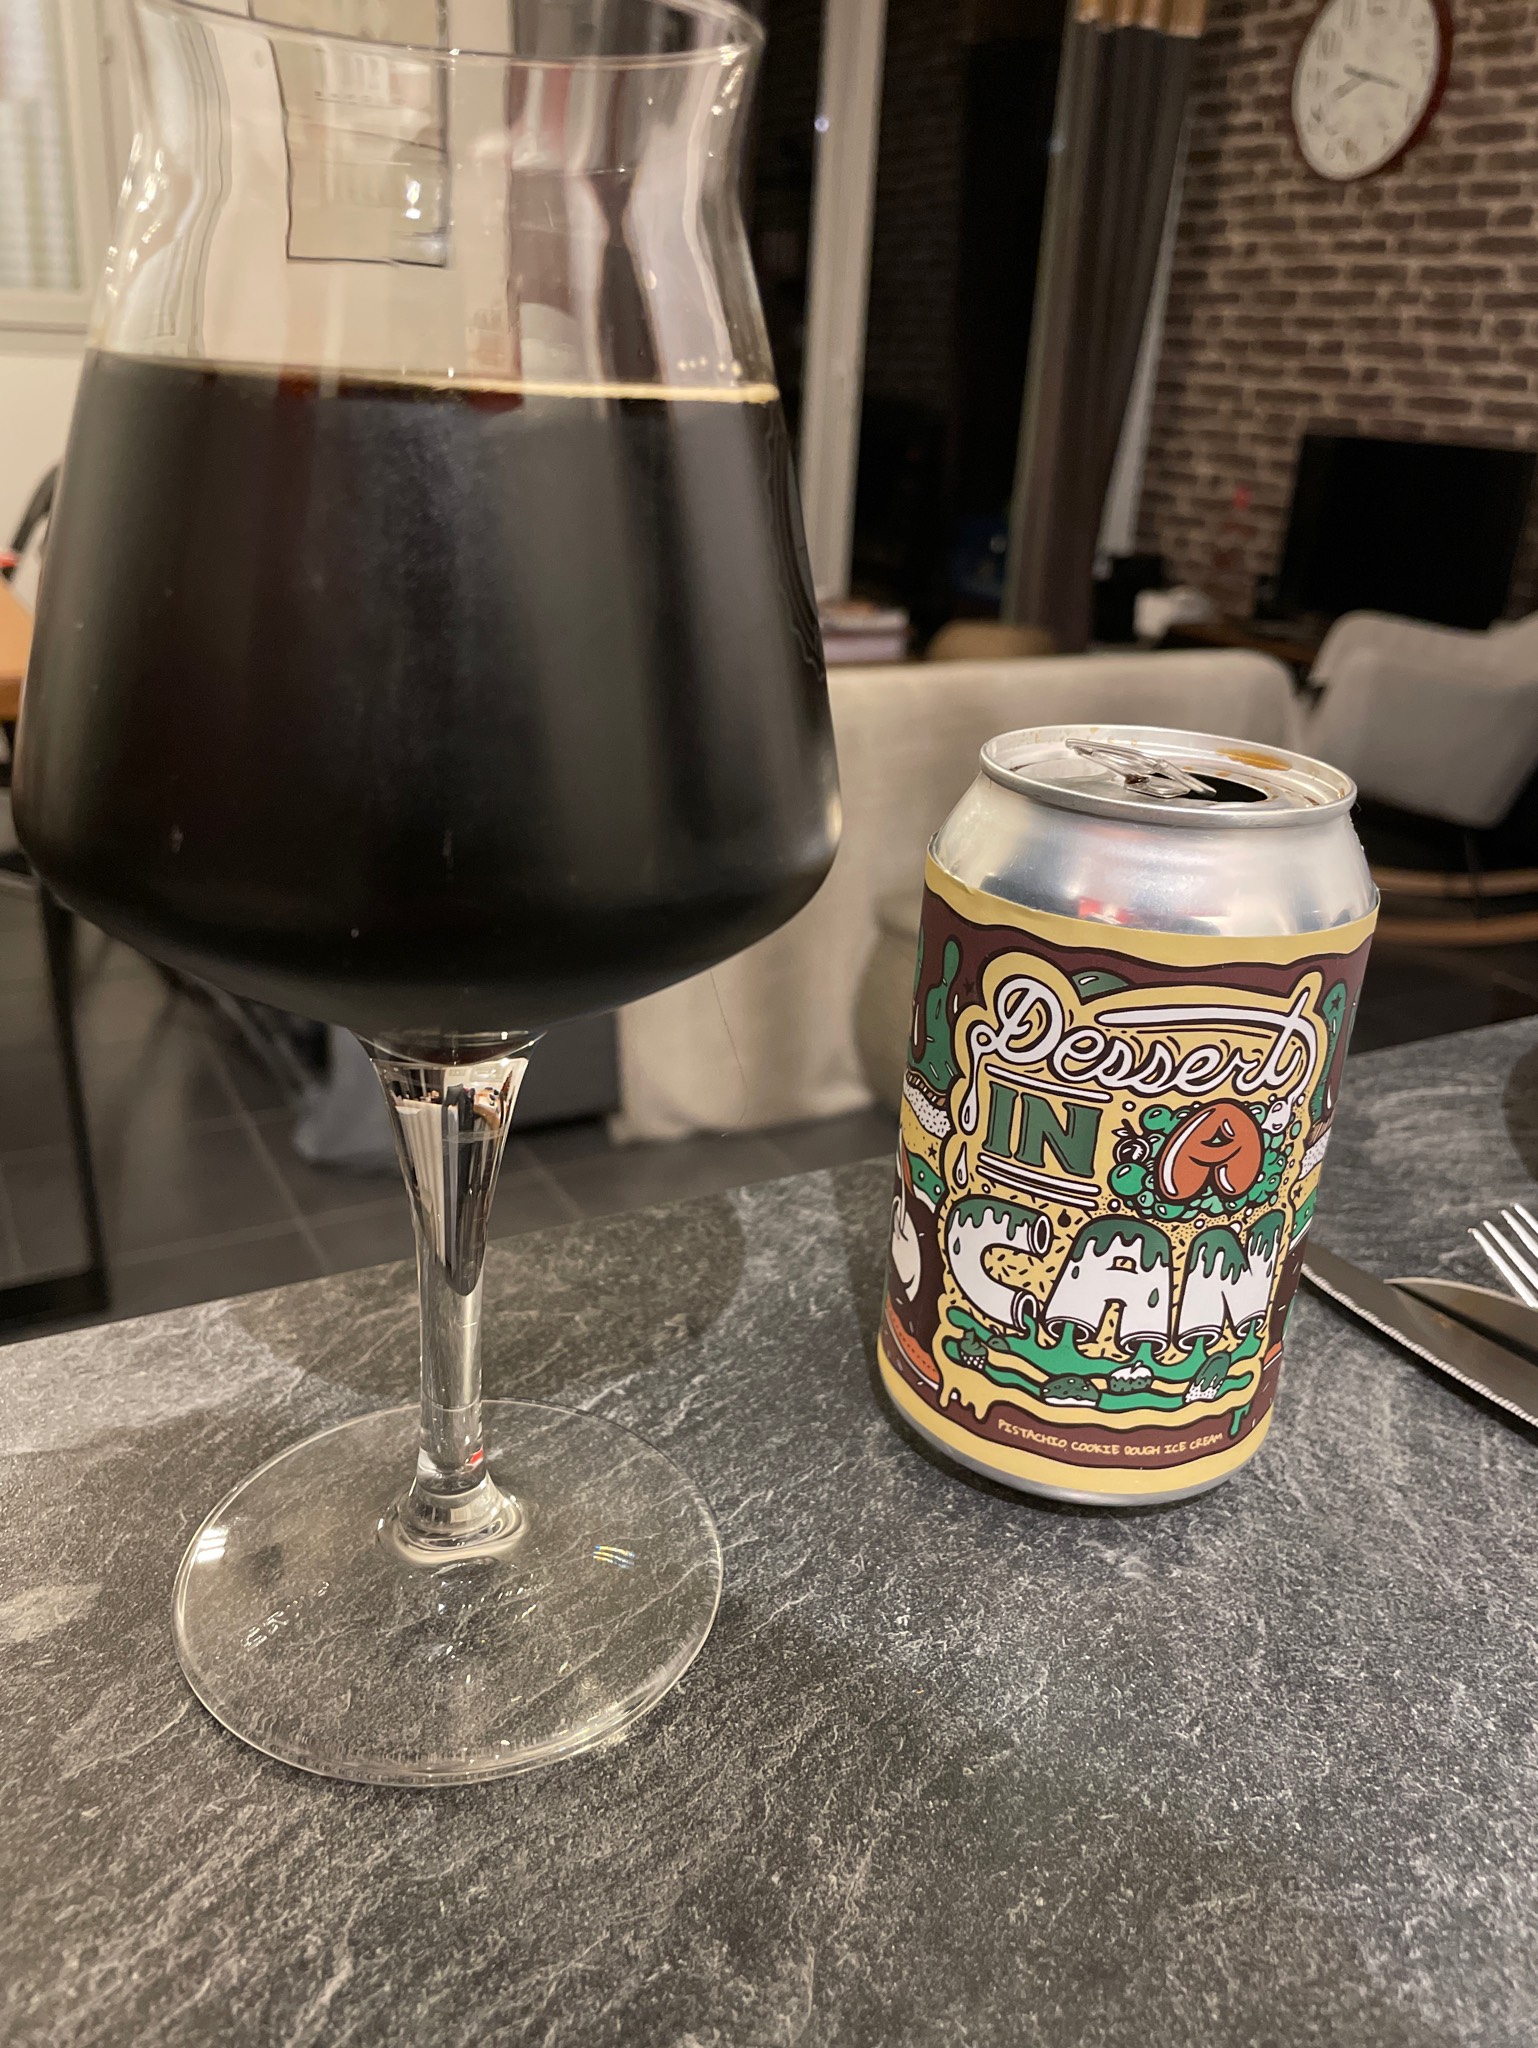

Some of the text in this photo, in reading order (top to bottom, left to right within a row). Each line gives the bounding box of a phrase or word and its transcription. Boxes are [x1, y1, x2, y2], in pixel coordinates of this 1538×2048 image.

[971, 978, 1317, 1094] Dessert
[982, 1081, 1264, 1201] IN A
[945, 1197, 1286, 1356] CAN
[1070, 1440, 1120, 1455] COOKIE
[1124, 1444, 1161, 1456] DOUGH
[1164, 1441, 1187, 1454] ICE
[1189, 1432, 1224, 1450] CREAM
